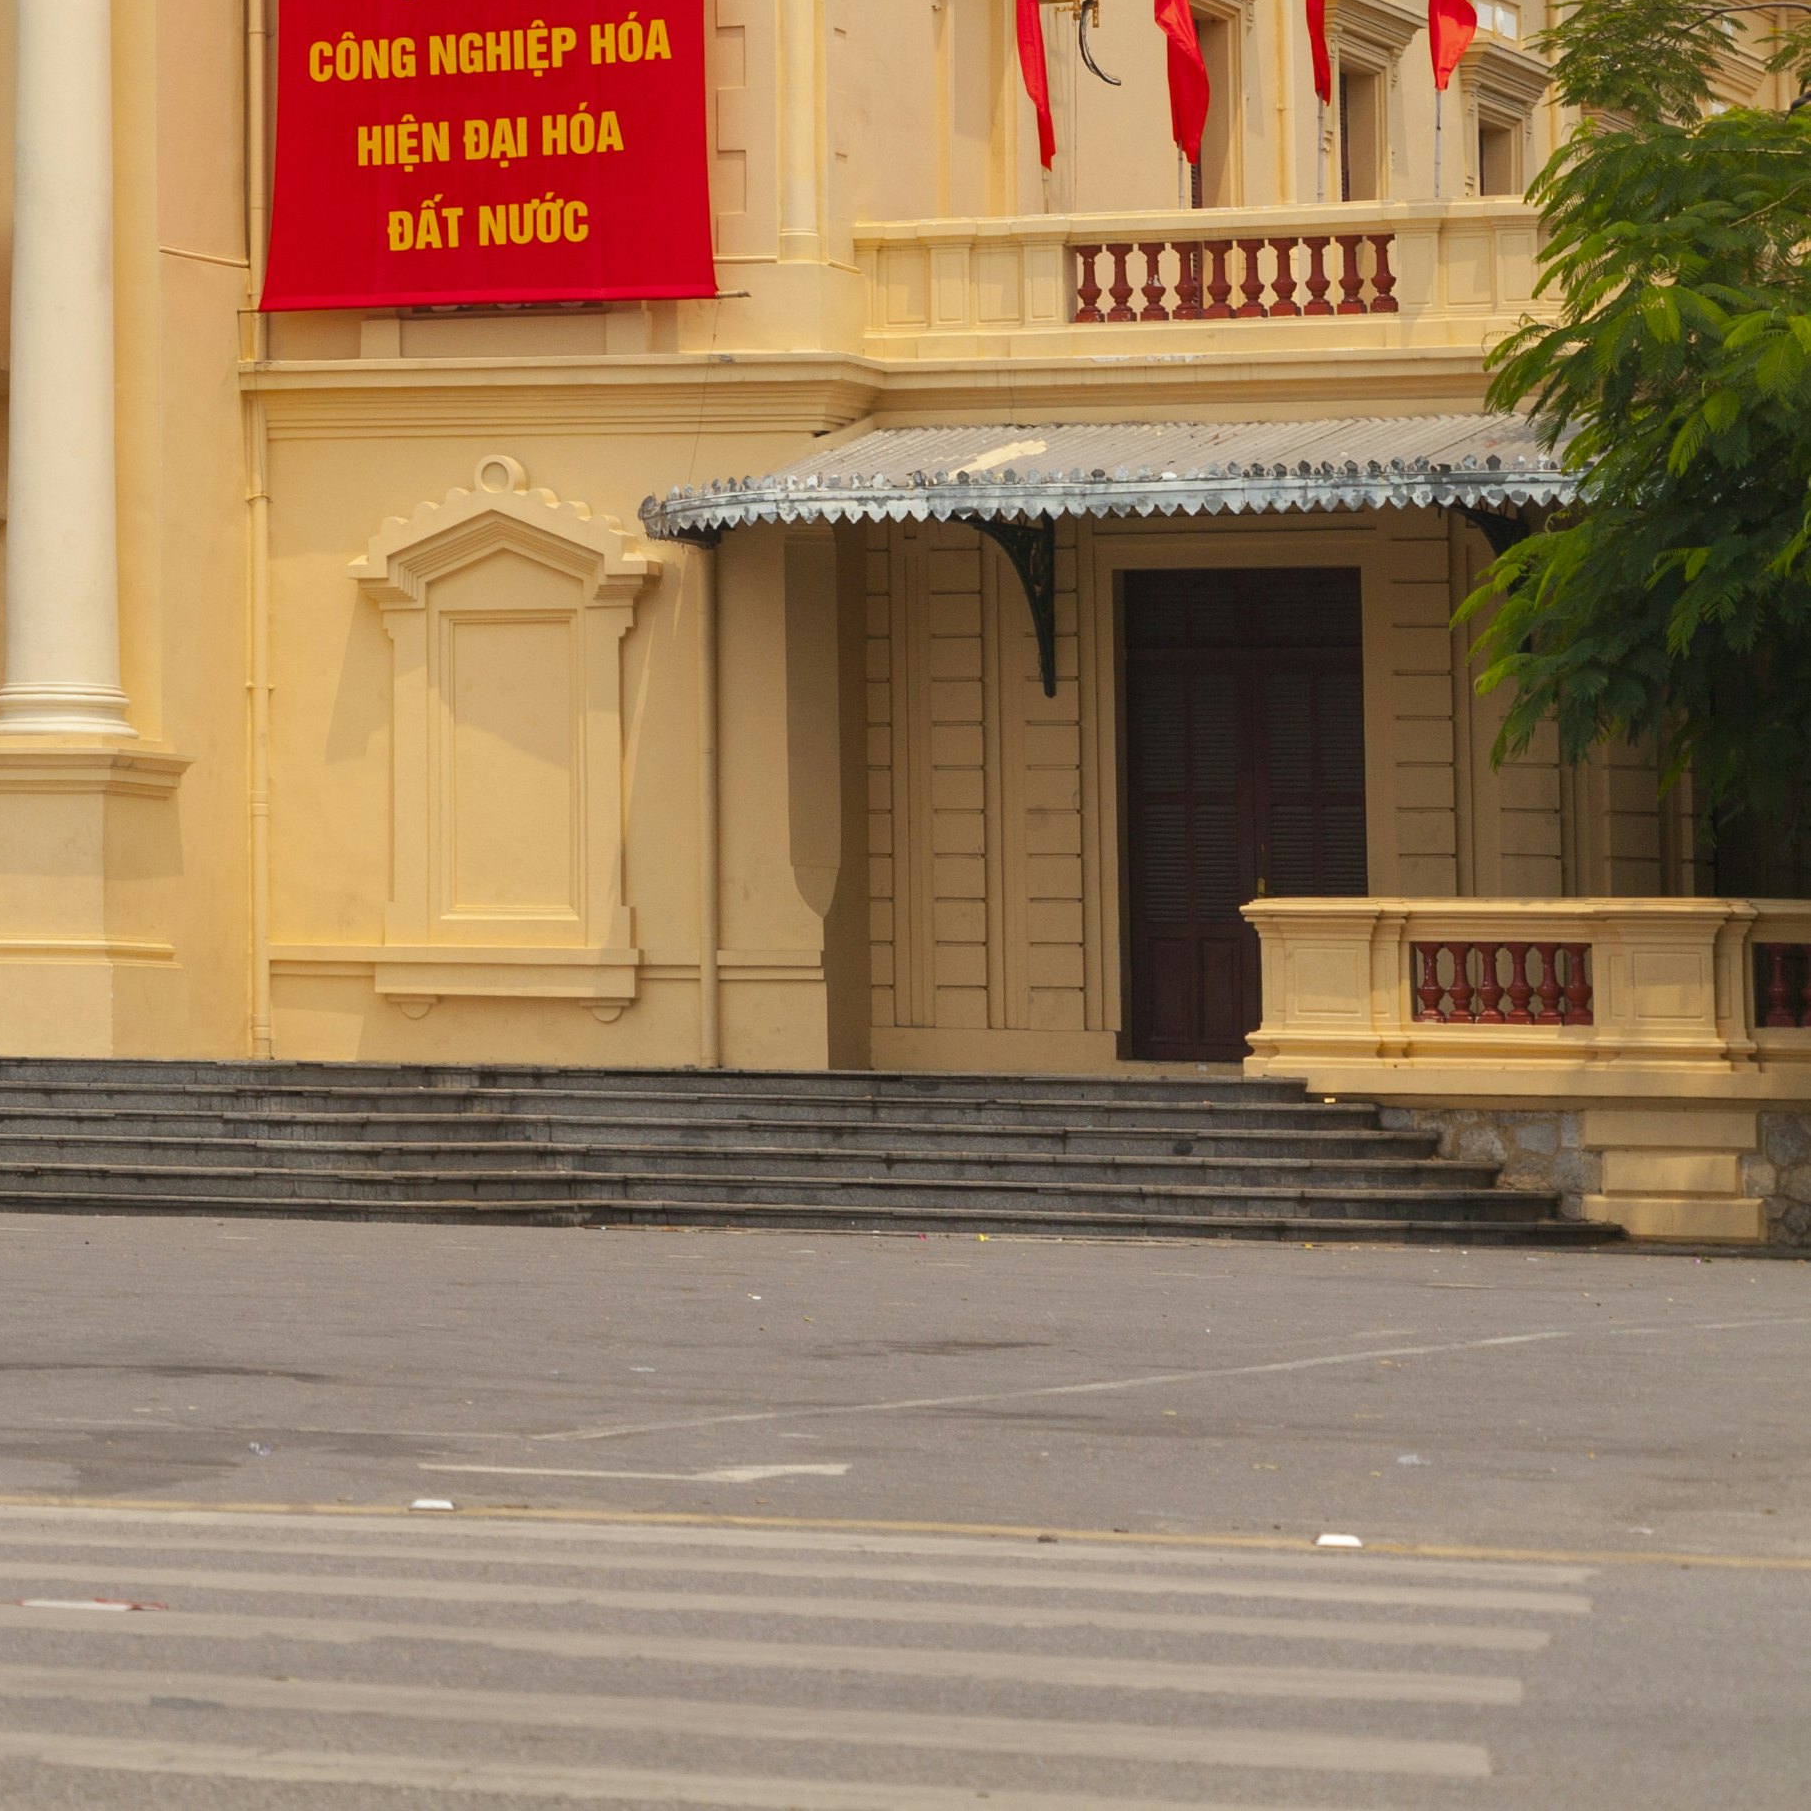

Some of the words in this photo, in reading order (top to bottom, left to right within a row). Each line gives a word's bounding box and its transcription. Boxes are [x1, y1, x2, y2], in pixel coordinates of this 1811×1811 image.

[309, 31, 416, 82] CÔNG
[429, 19, 577, 77] NGHIỆP
[590, 11, 672, 65] HÓA
[358, 114, 450, 173] HIỆN
[463, 116, 528, 168] ĐẠI
[542, 102, 624, 156] HÓA
[387, 194, 464, 251] ĐẤT
[479, 192, 589, 246] NƯỚC
